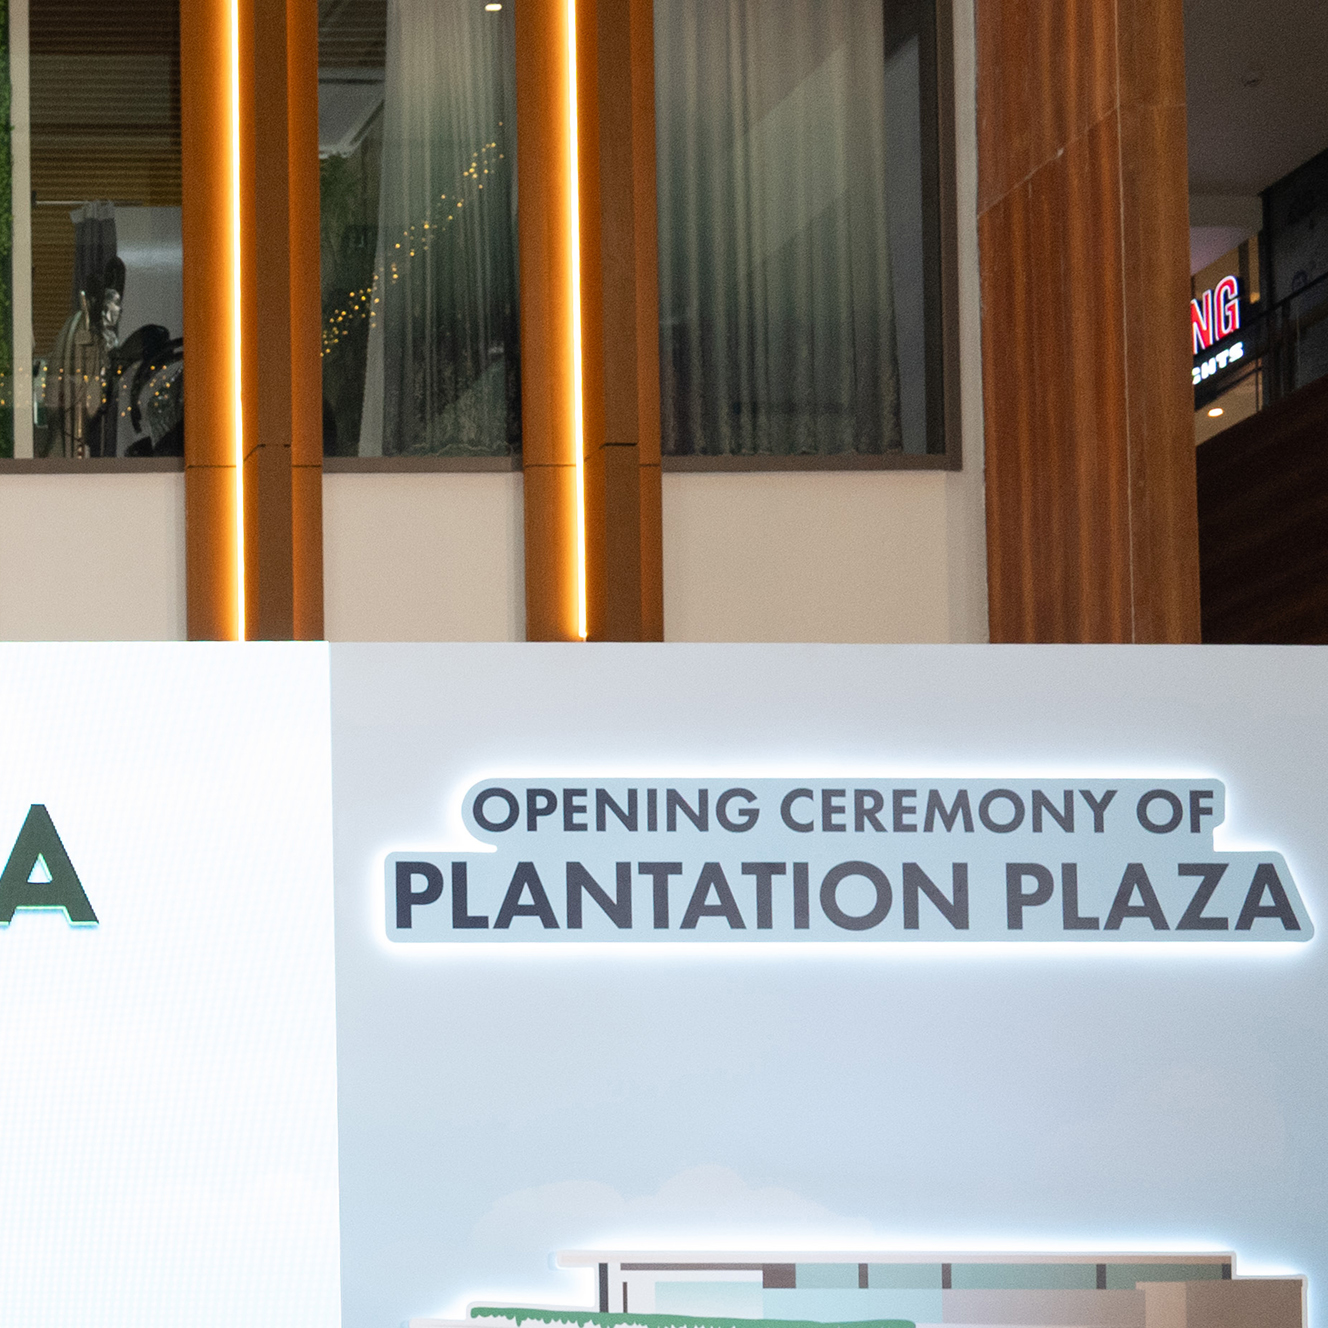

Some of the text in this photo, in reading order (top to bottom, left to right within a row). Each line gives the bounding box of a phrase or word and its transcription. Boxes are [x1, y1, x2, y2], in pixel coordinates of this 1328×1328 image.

[1191, 276, 1240, 354] NG
[473, 787, 1215, 836] OPENING CEREMONY OF
[395, 859, 1302, 932] PLANTATION PLAZA
